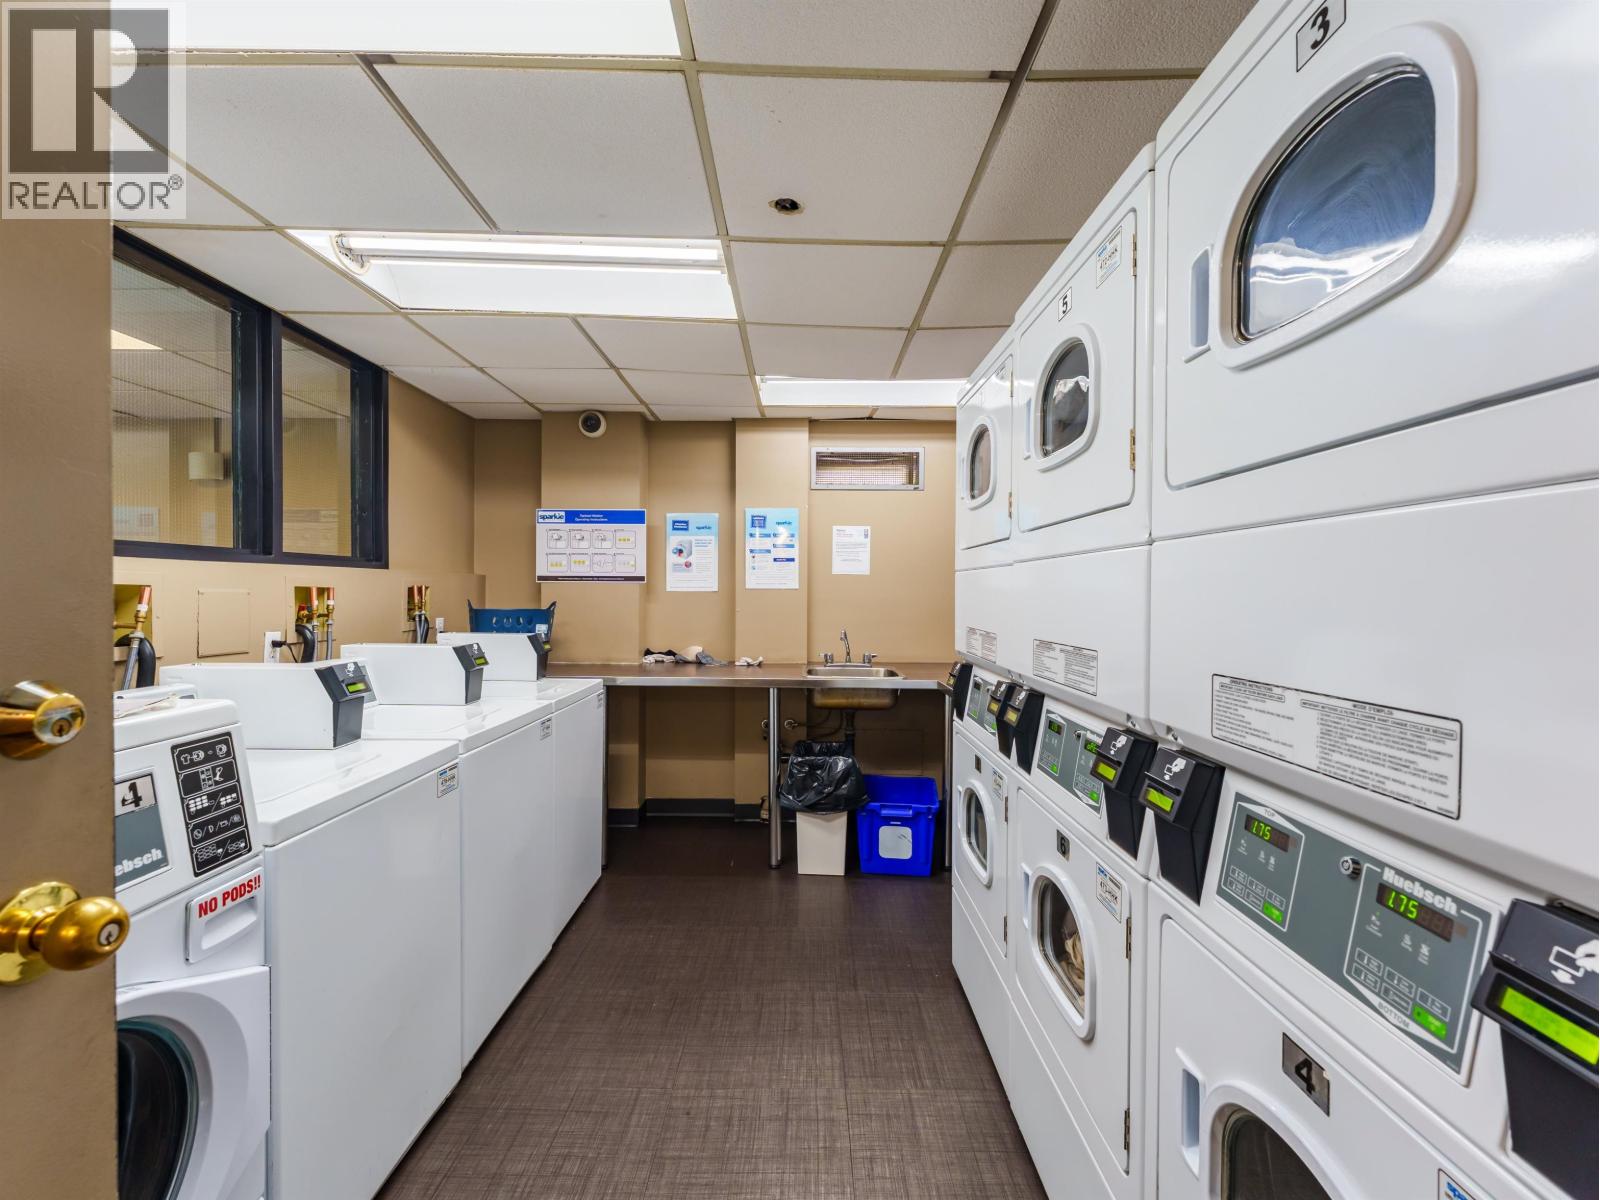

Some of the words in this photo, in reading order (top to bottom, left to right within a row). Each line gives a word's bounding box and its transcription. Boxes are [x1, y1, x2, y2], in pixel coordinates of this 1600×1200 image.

[1311, 6, 1330, 50] 3
[1062, 294, 1068, 314] 5
[121, 781, 143, 808] 4
[1061, 836, 1067, 855] 6
[198, 896, 218, 919] NO
[222, 874, 261, 907] PODS!!
[1382, 866, 1458, 918] Huebsch
[1378, 1001, 1410, 1029] BOTTOM
[1294, 1057, 1315, 1095] 4
